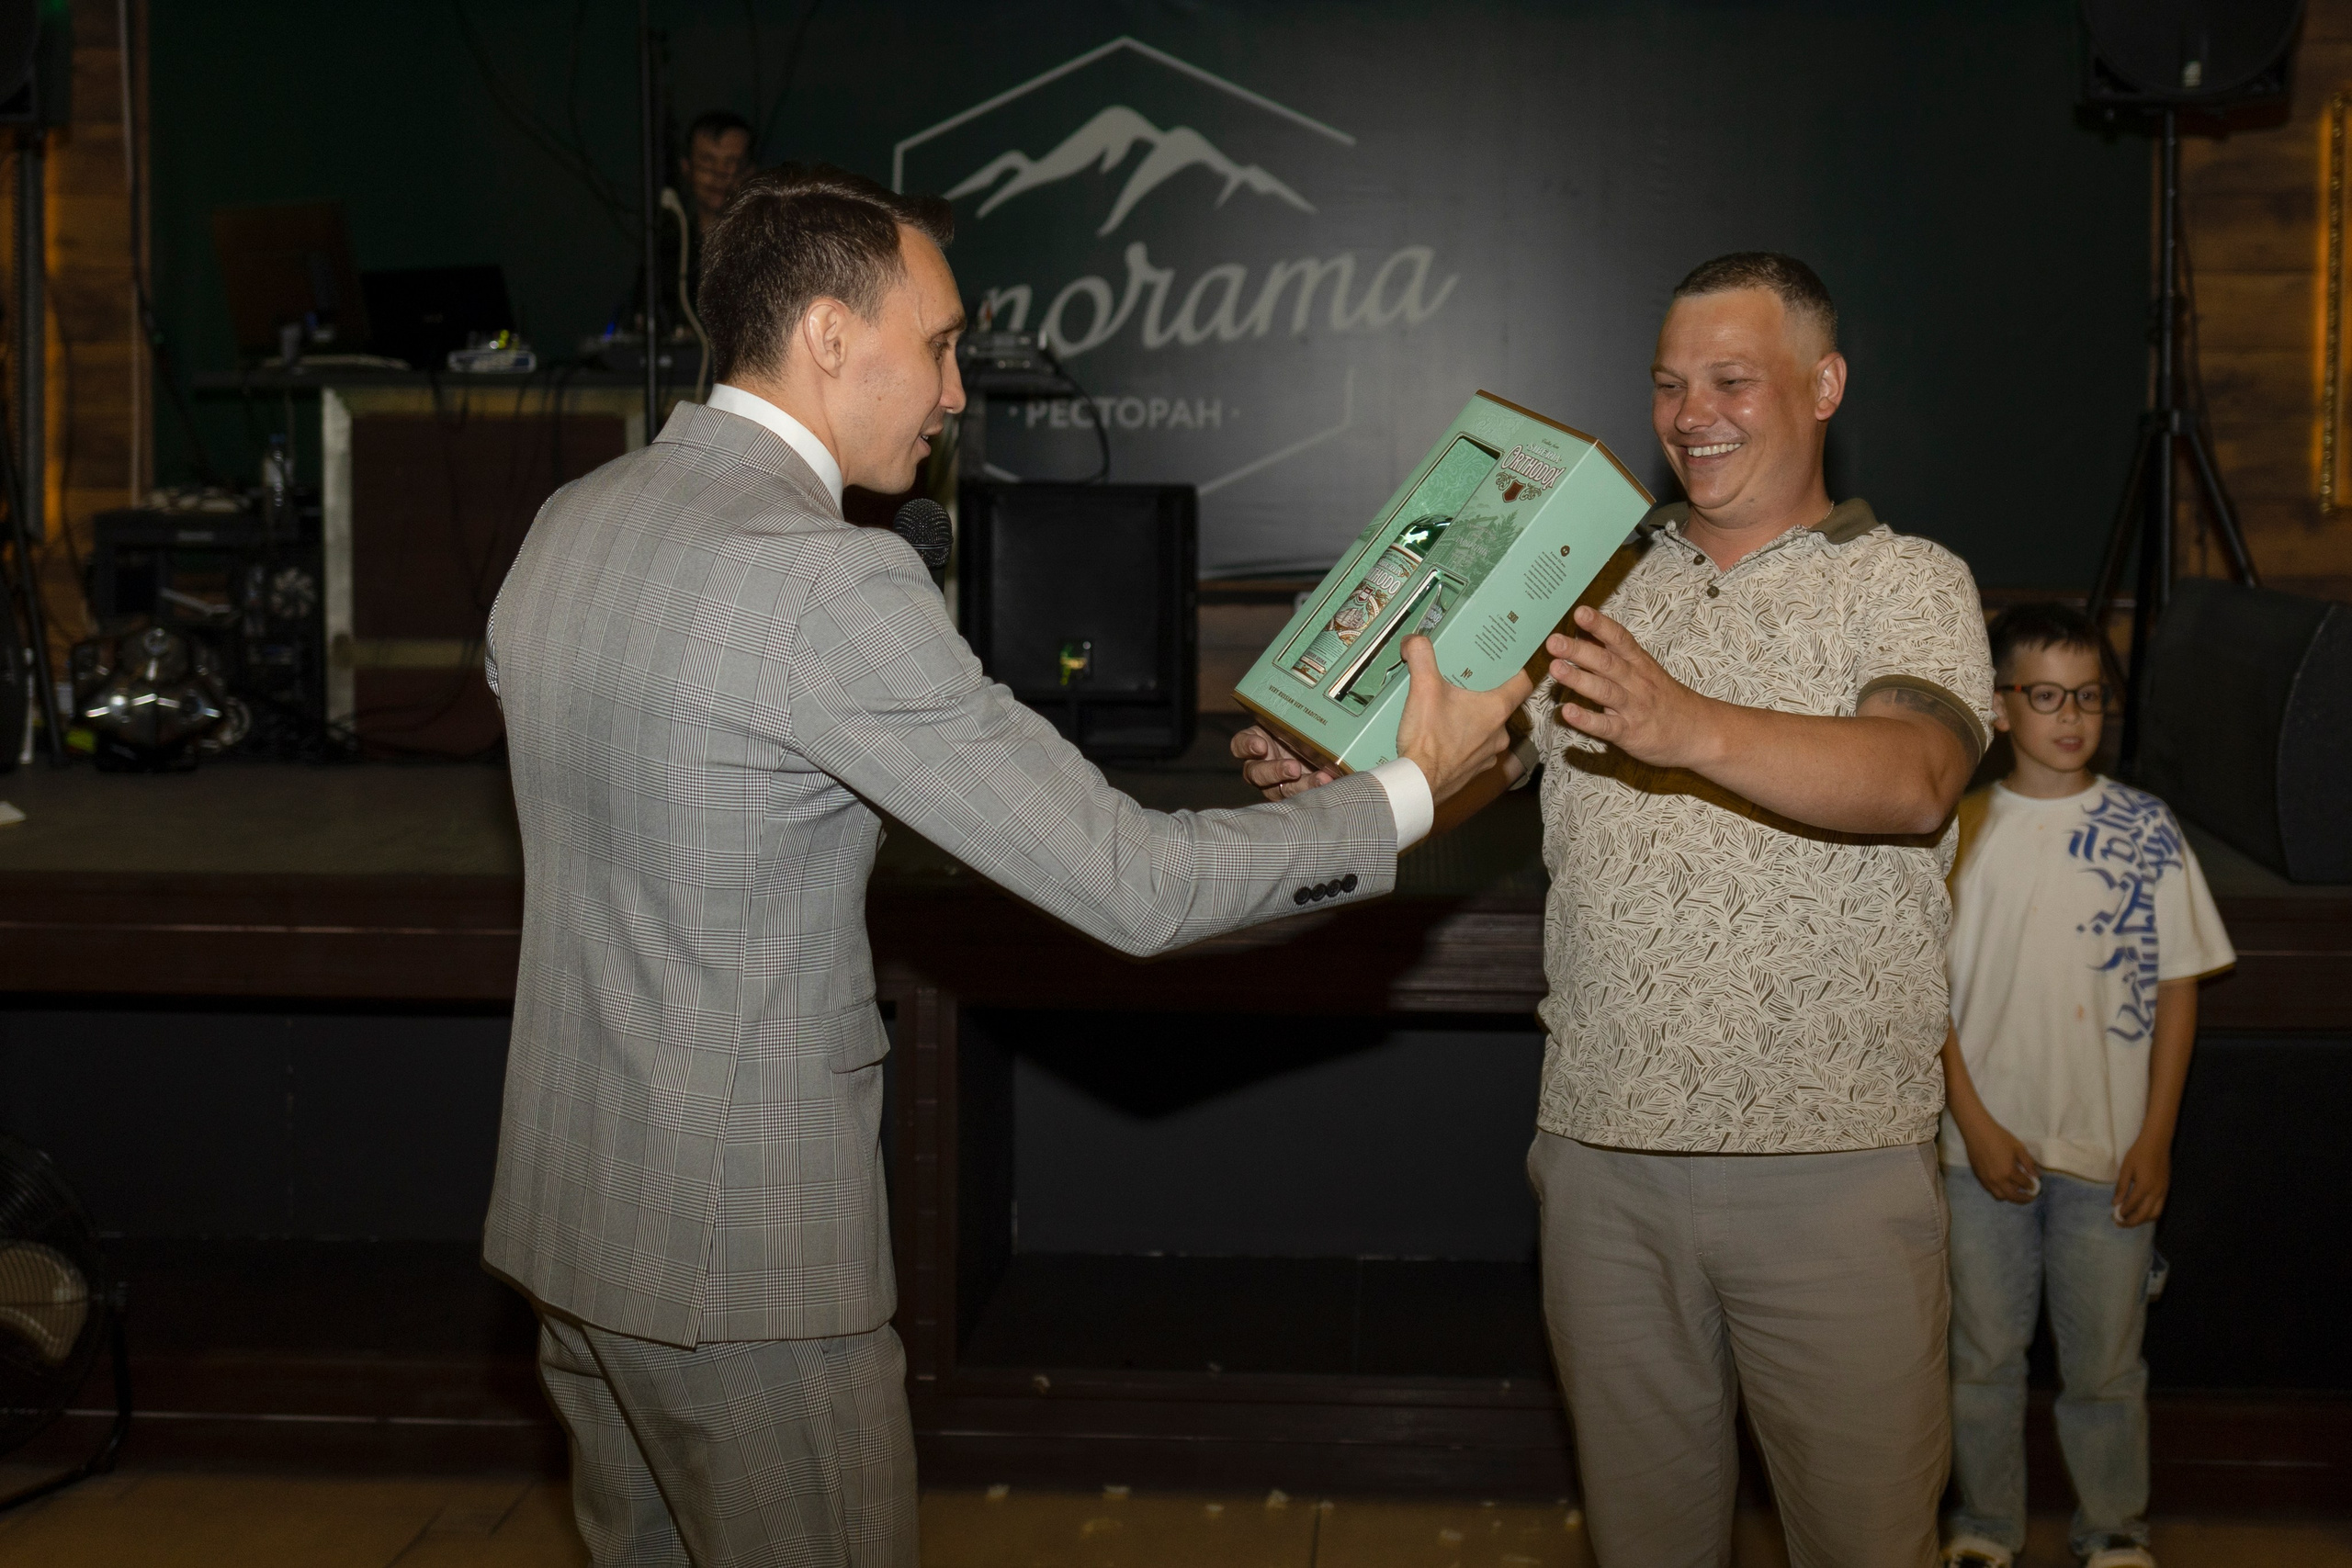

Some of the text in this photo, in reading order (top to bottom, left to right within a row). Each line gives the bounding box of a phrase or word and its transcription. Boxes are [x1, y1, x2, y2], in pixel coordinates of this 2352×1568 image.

[978, 241, 1461, 360] norama
[1025, 396, 1223, 430] РЕСТОРАН
[1500, 444, 1566, 491] ORTHODOX
[1527, 442, 1562, 464] SIBERIA
